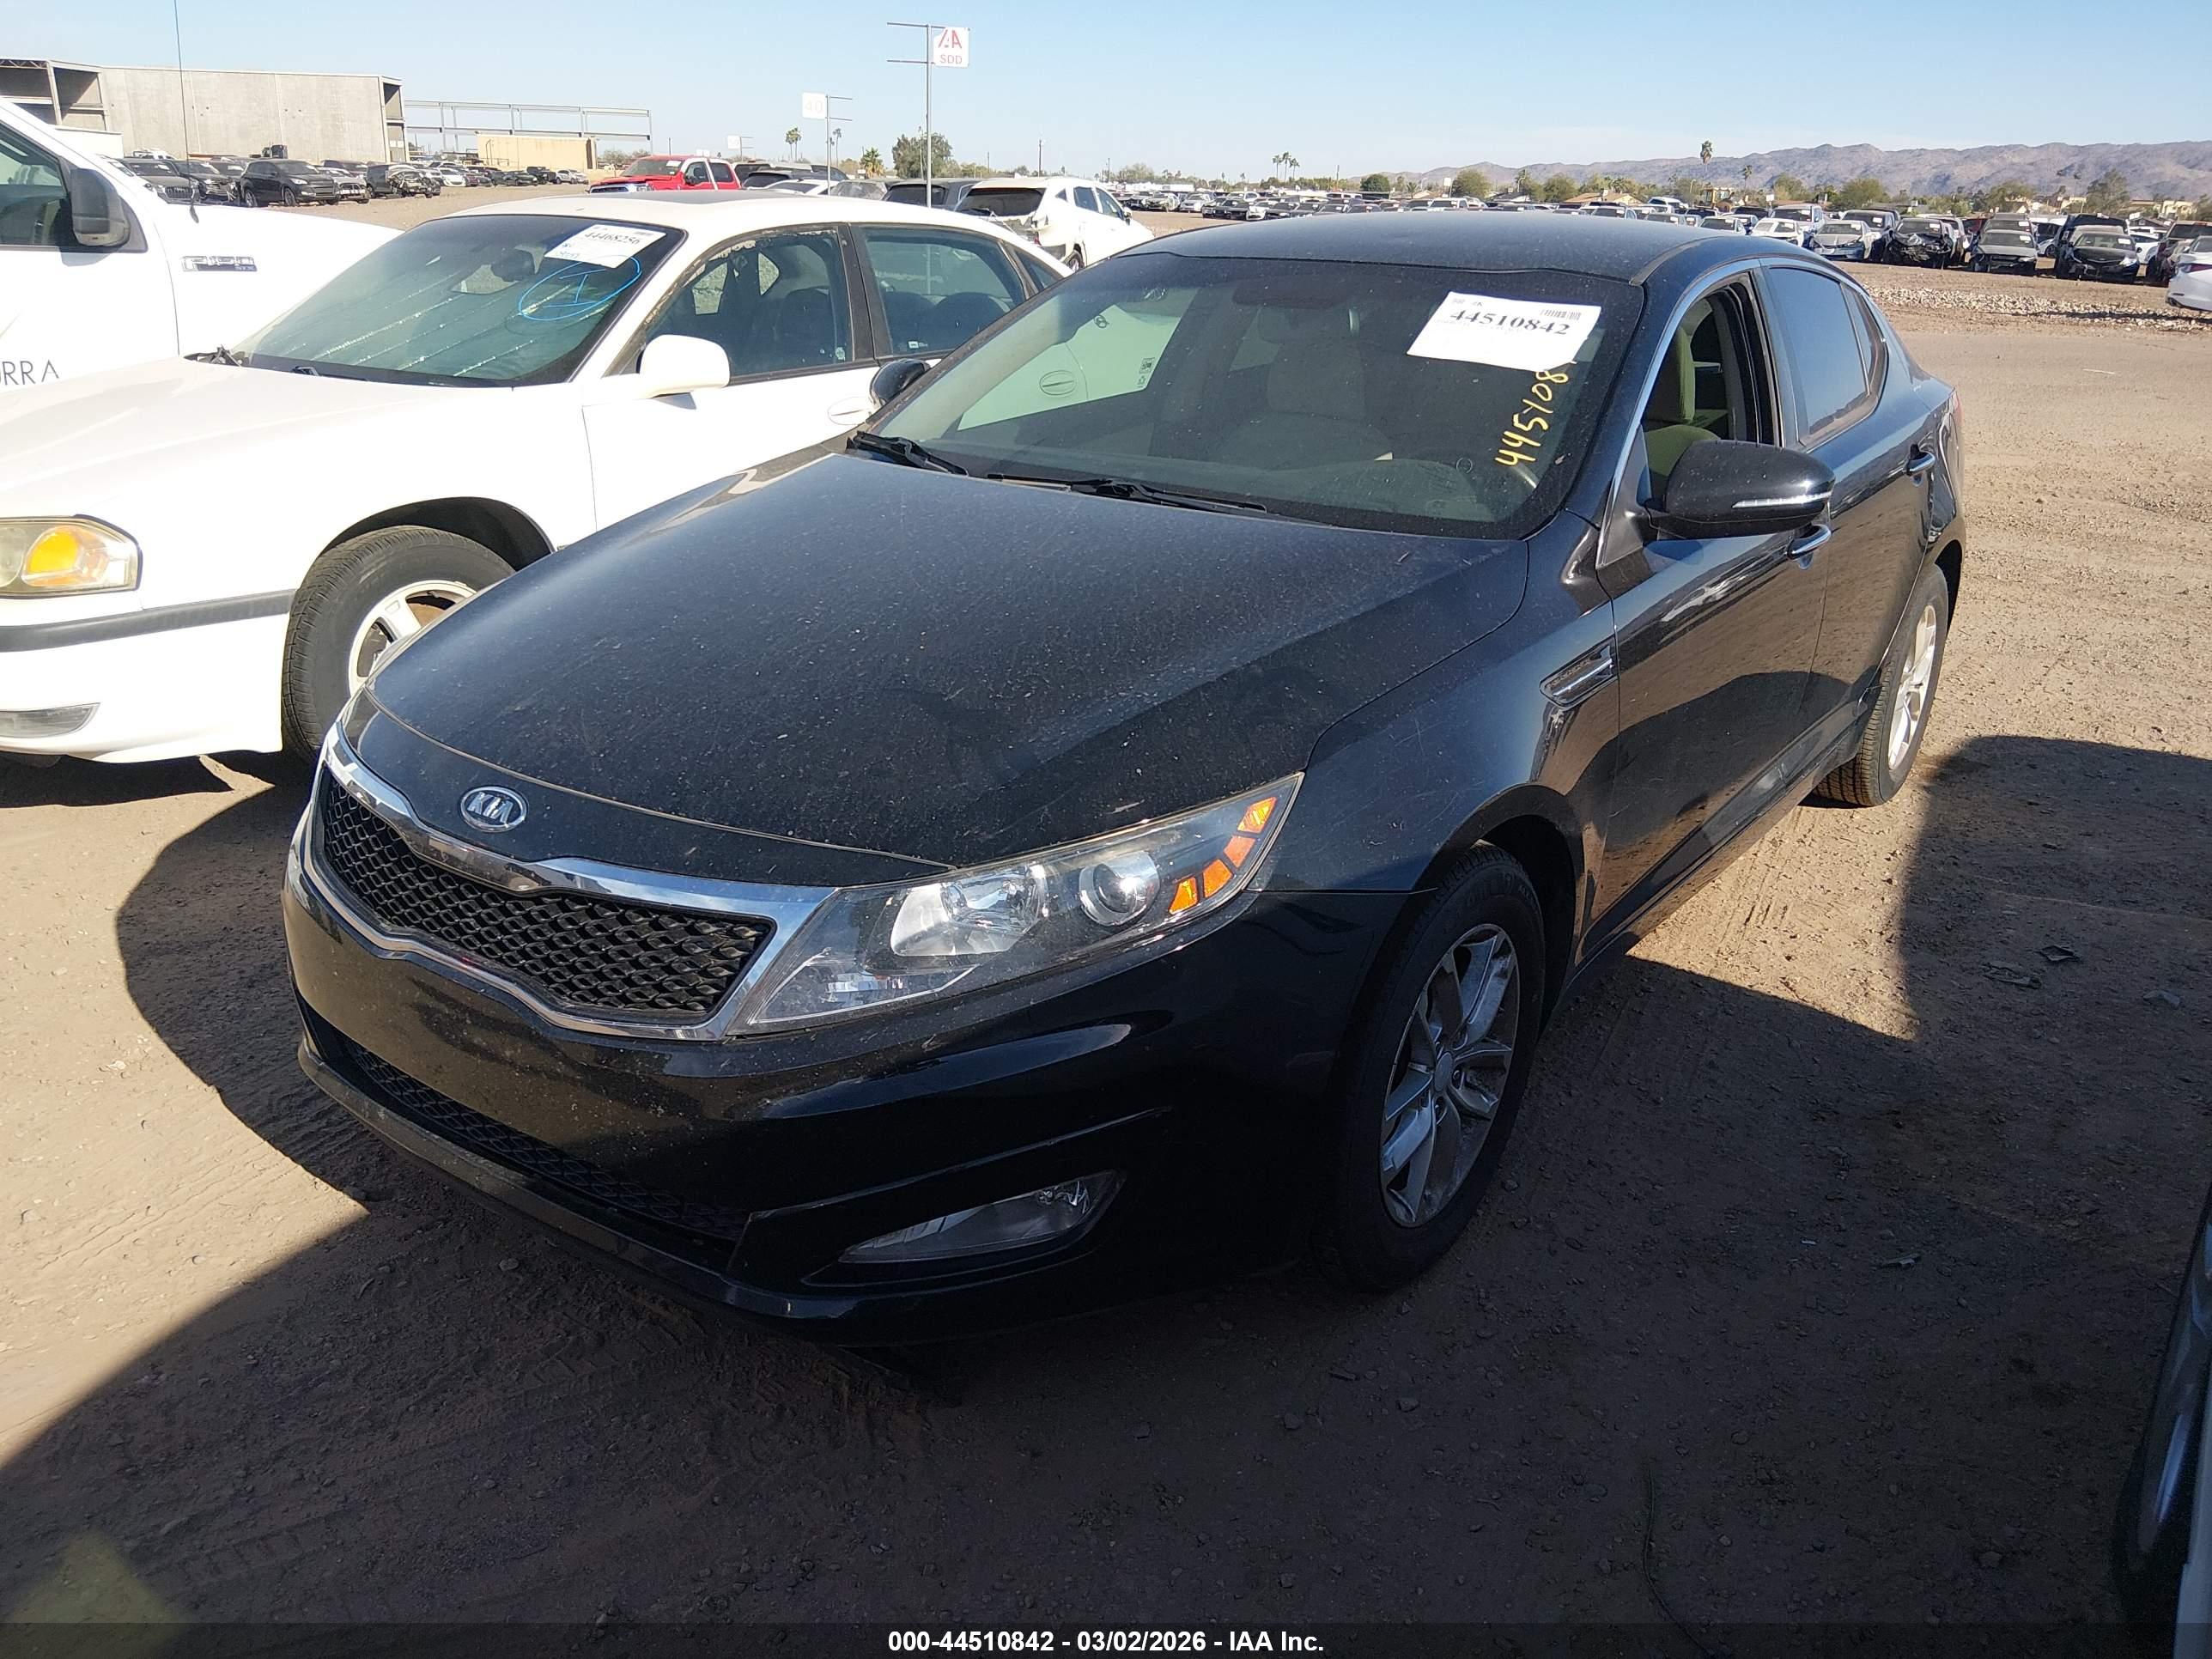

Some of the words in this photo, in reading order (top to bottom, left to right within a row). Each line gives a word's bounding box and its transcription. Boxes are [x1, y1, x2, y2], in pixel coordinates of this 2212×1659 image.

[939, 54, 963, 64] SDD
[1449, 309, 1571, 335] 44510842
[0, 360, 59, 386] RRA
